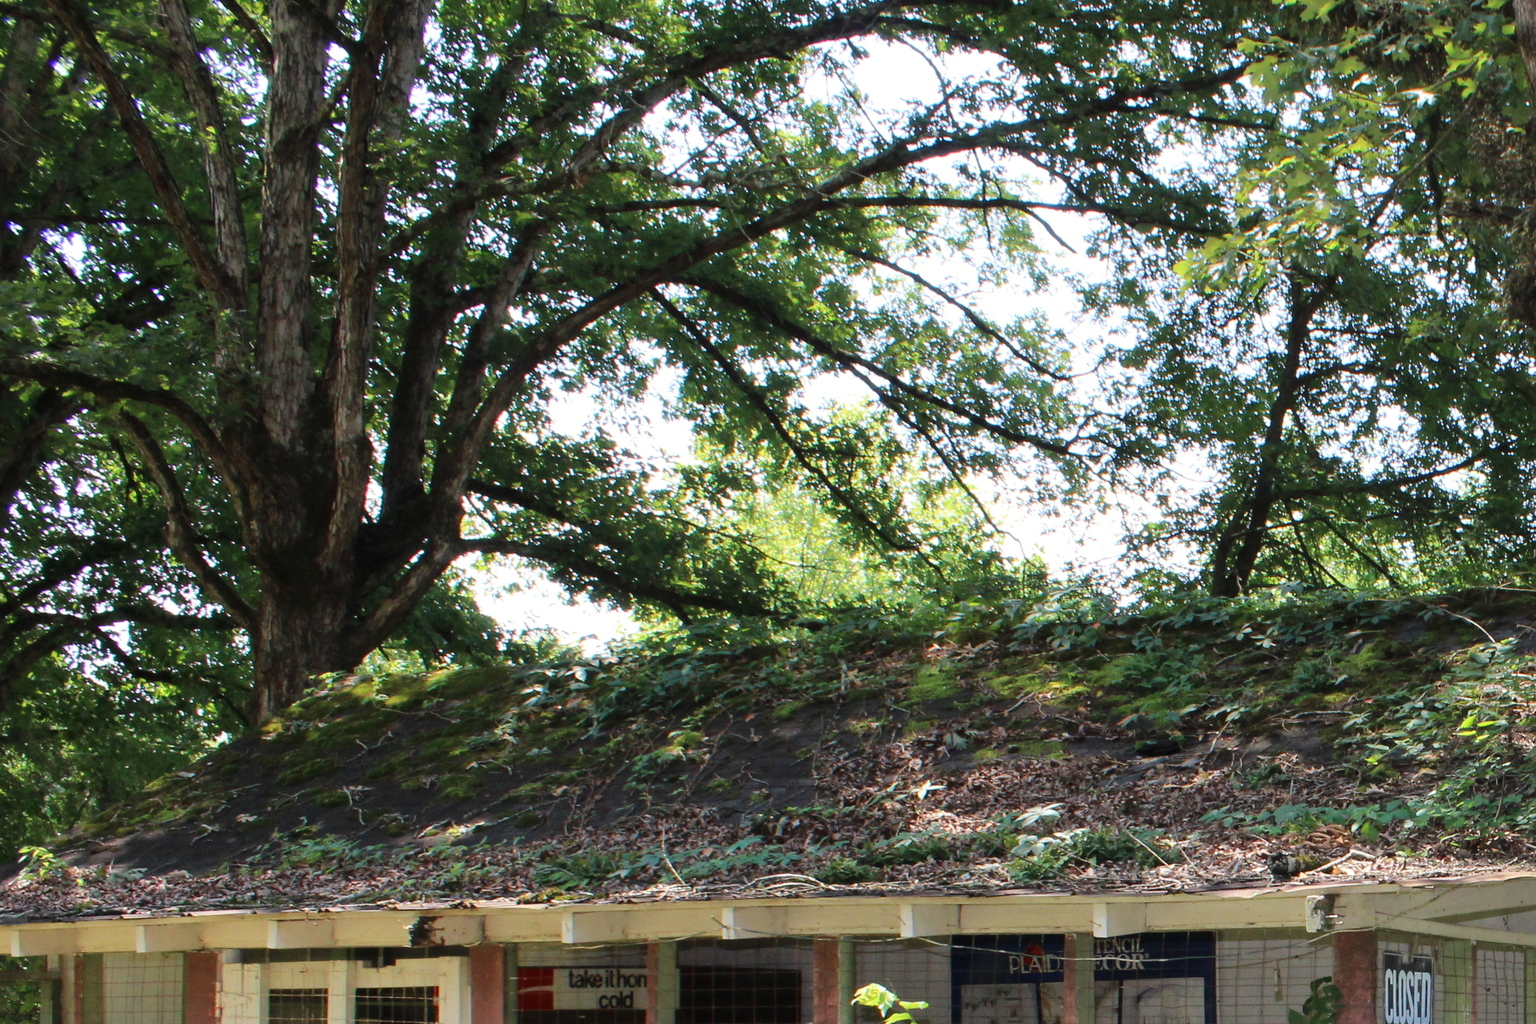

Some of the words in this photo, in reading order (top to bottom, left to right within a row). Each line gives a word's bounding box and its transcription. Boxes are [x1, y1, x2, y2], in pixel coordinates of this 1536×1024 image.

[1094, 937, 1145, 953] TENCIL
[1009, 953, 1061, 974] PLAID
[568, 969, 603, 988] take
[605, 969, 614, 988] it
[599, 991, 634, 1009] cold
